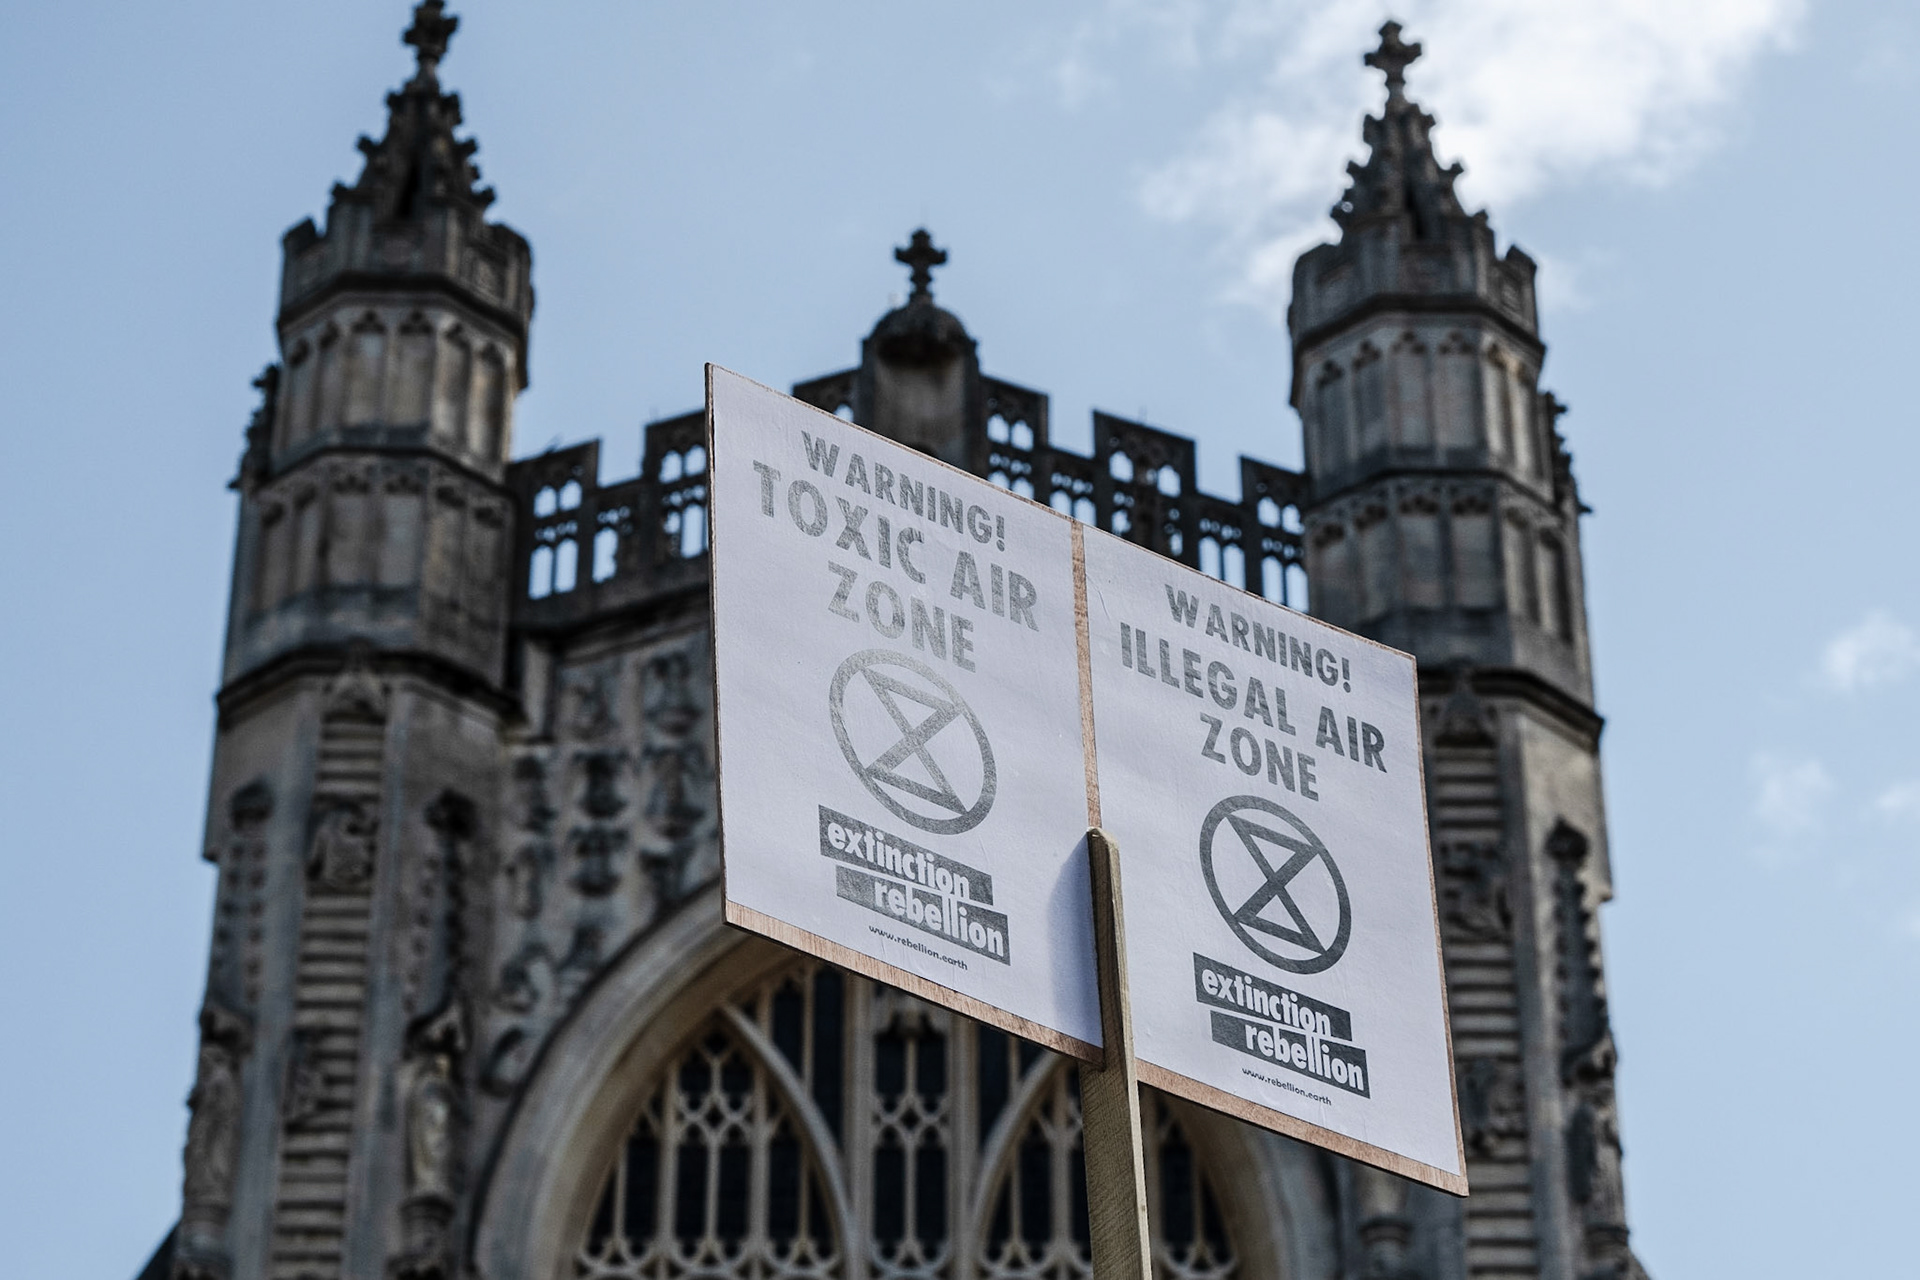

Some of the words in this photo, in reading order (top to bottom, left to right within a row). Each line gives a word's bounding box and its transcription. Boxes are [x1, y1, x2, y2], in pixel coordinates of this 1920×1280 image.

[801, 430, 1005, 552] WARNING!
[753, 459, 926, 584] TOXIC
[950, 550, 1039, 632] AIR
[827, 560, 976, 673] ZONE
[1164, 583, 1351, 693] WARNING!
[1120, 622, 1296, 736] ILLEGAL
[1315, 706, 1387, 773] AIR
[1200, 712, 1319, 802] ZONE
[827, 822, 970, 900] extinction
[868, 924, 968, 971] www.rebellion.earth
[874, 880, 1004, 957] rebellion
[1202, 969, 1331, 1037] extinction
[1242, 1067, 1332, 1106] www.rebellion.earth
[1245, 1024, 1364, 1091] rebellion
